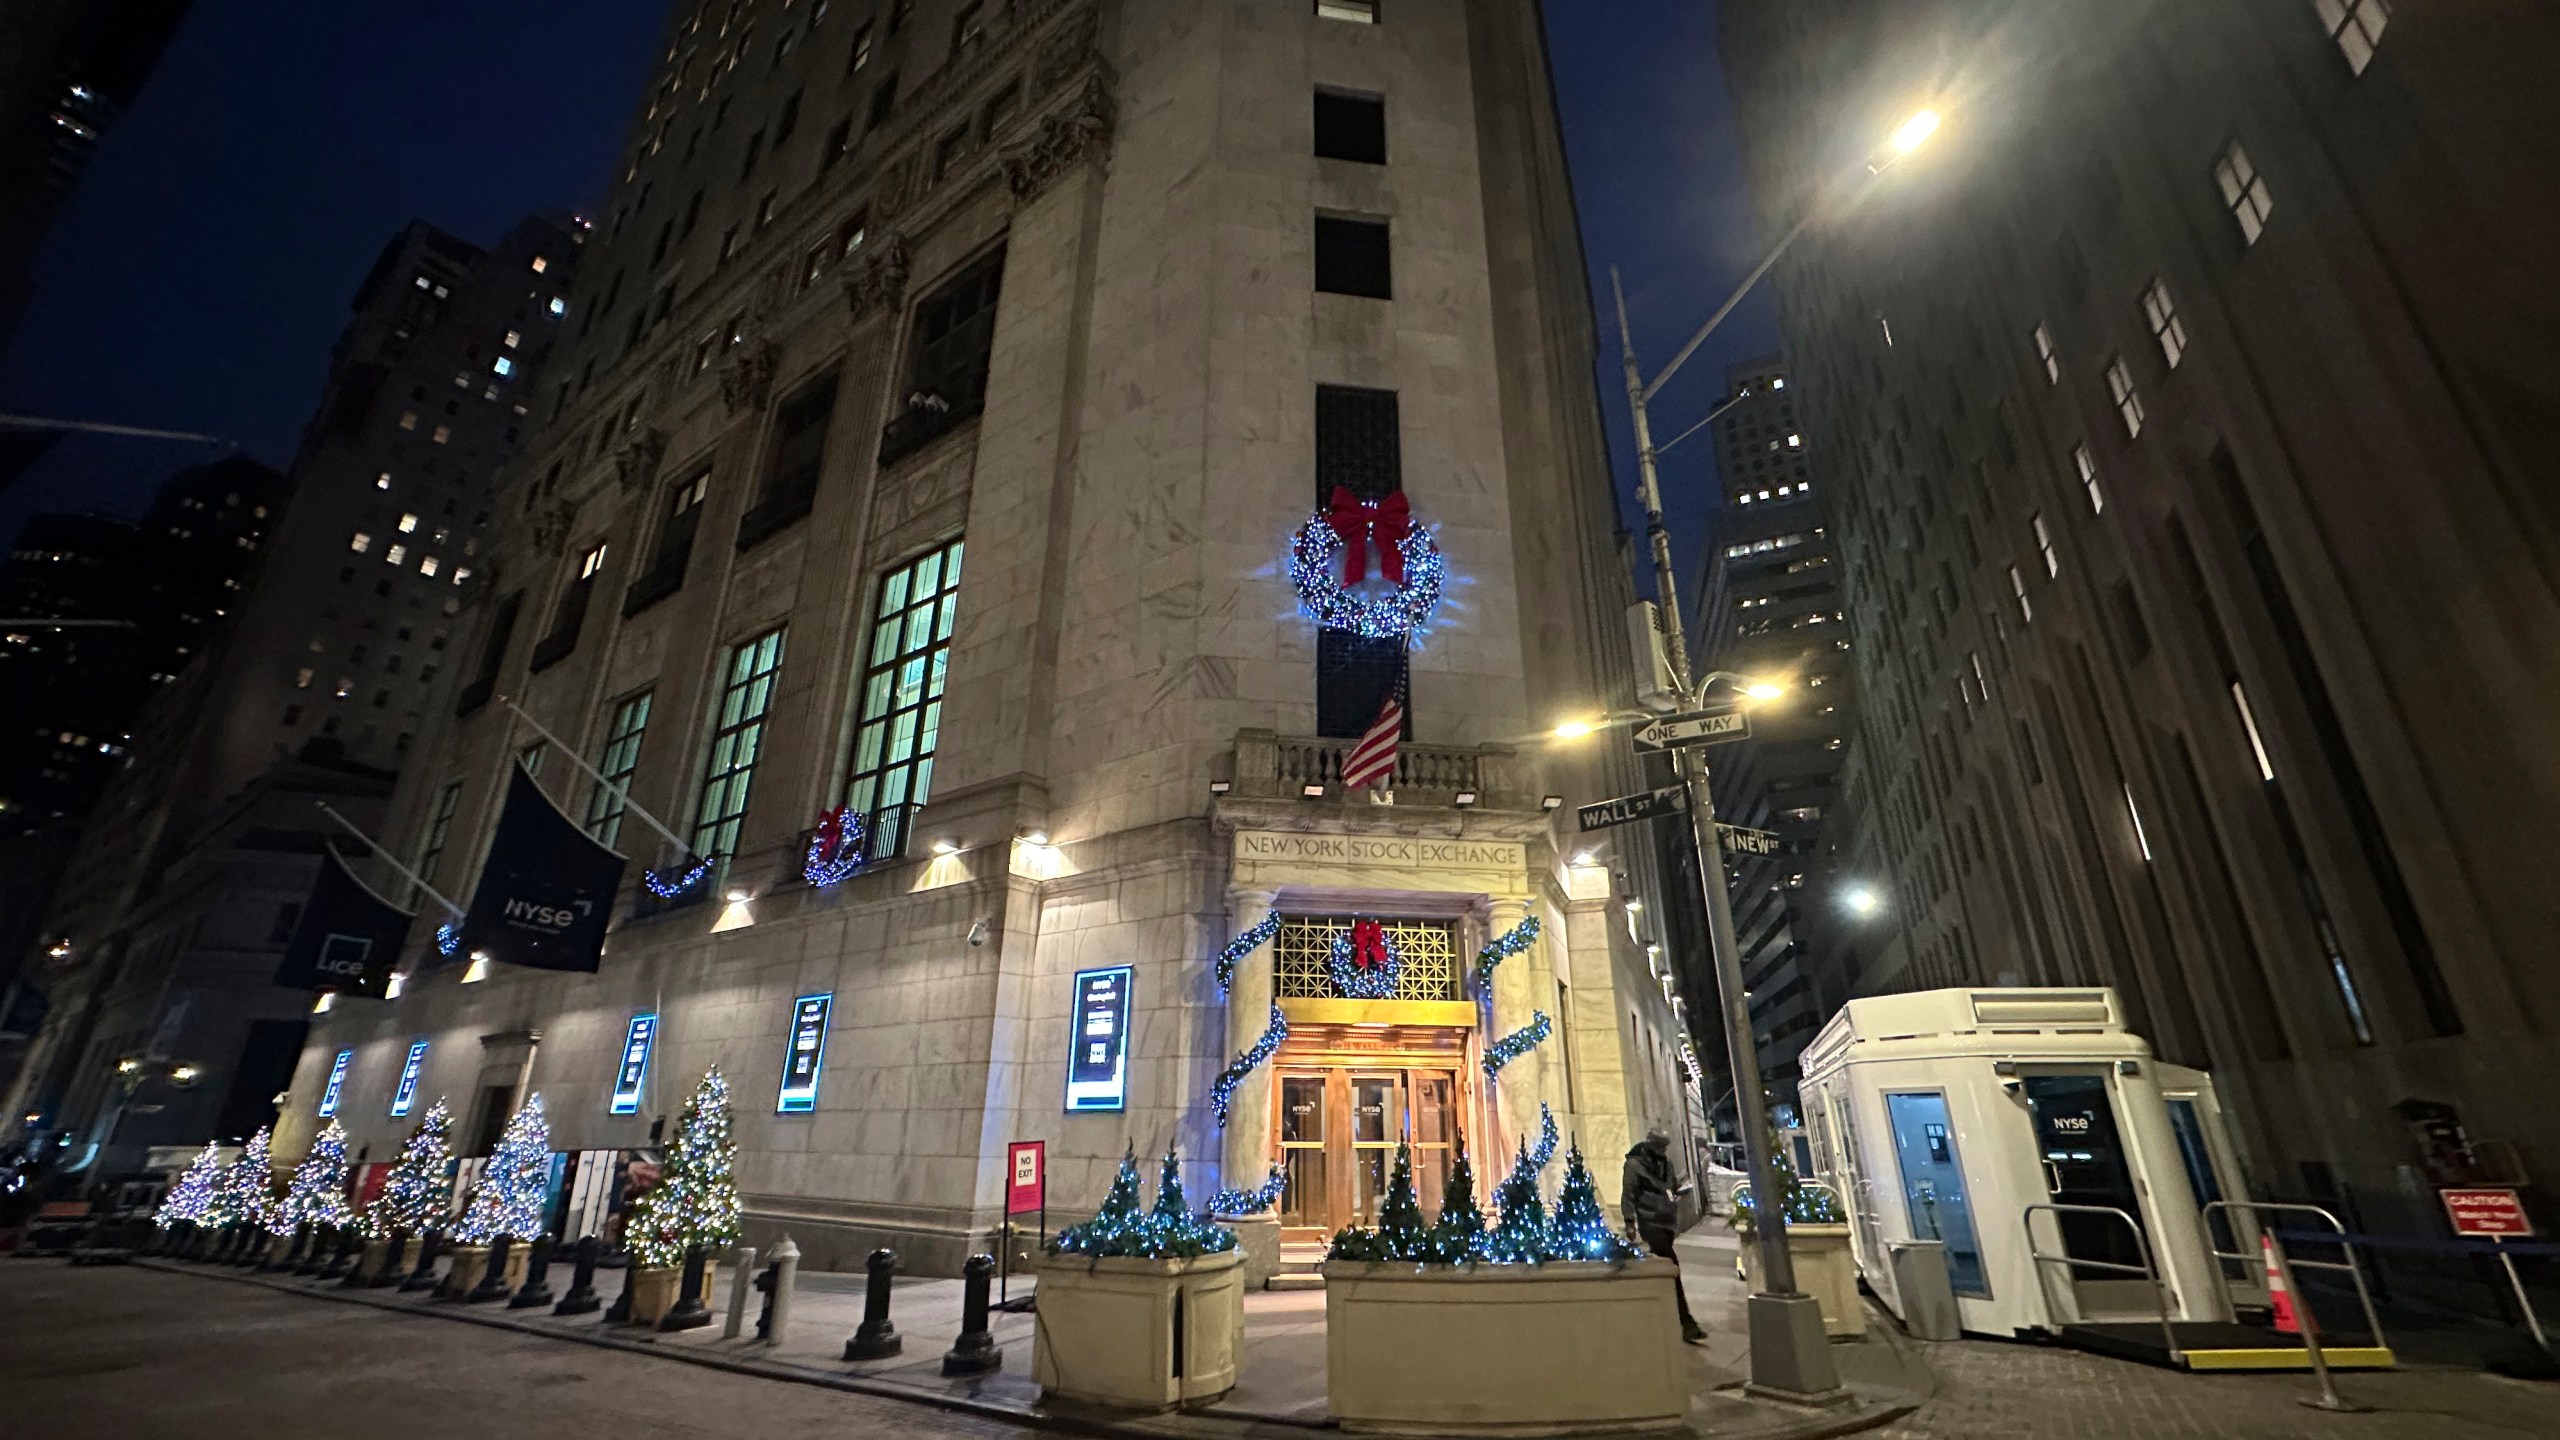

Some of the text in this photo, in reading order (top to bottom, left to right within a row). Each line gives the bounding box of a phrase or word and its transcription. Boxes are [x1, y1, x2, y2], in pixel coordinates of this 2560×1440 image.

[1647, 716, 1732, 741] ONE WAY
[1583, 804, 1636, 828] WALL
[1636, 800, 1650, 811] ST
[1245, 836, 1517, 865] NEW YORK STOCK EXCHANGE
[1736, 834, 1779, 854] NEW ST
[1021, 1156, 1031, 1165] NO
[1018, 1169, 1033, 1178] EXIT
